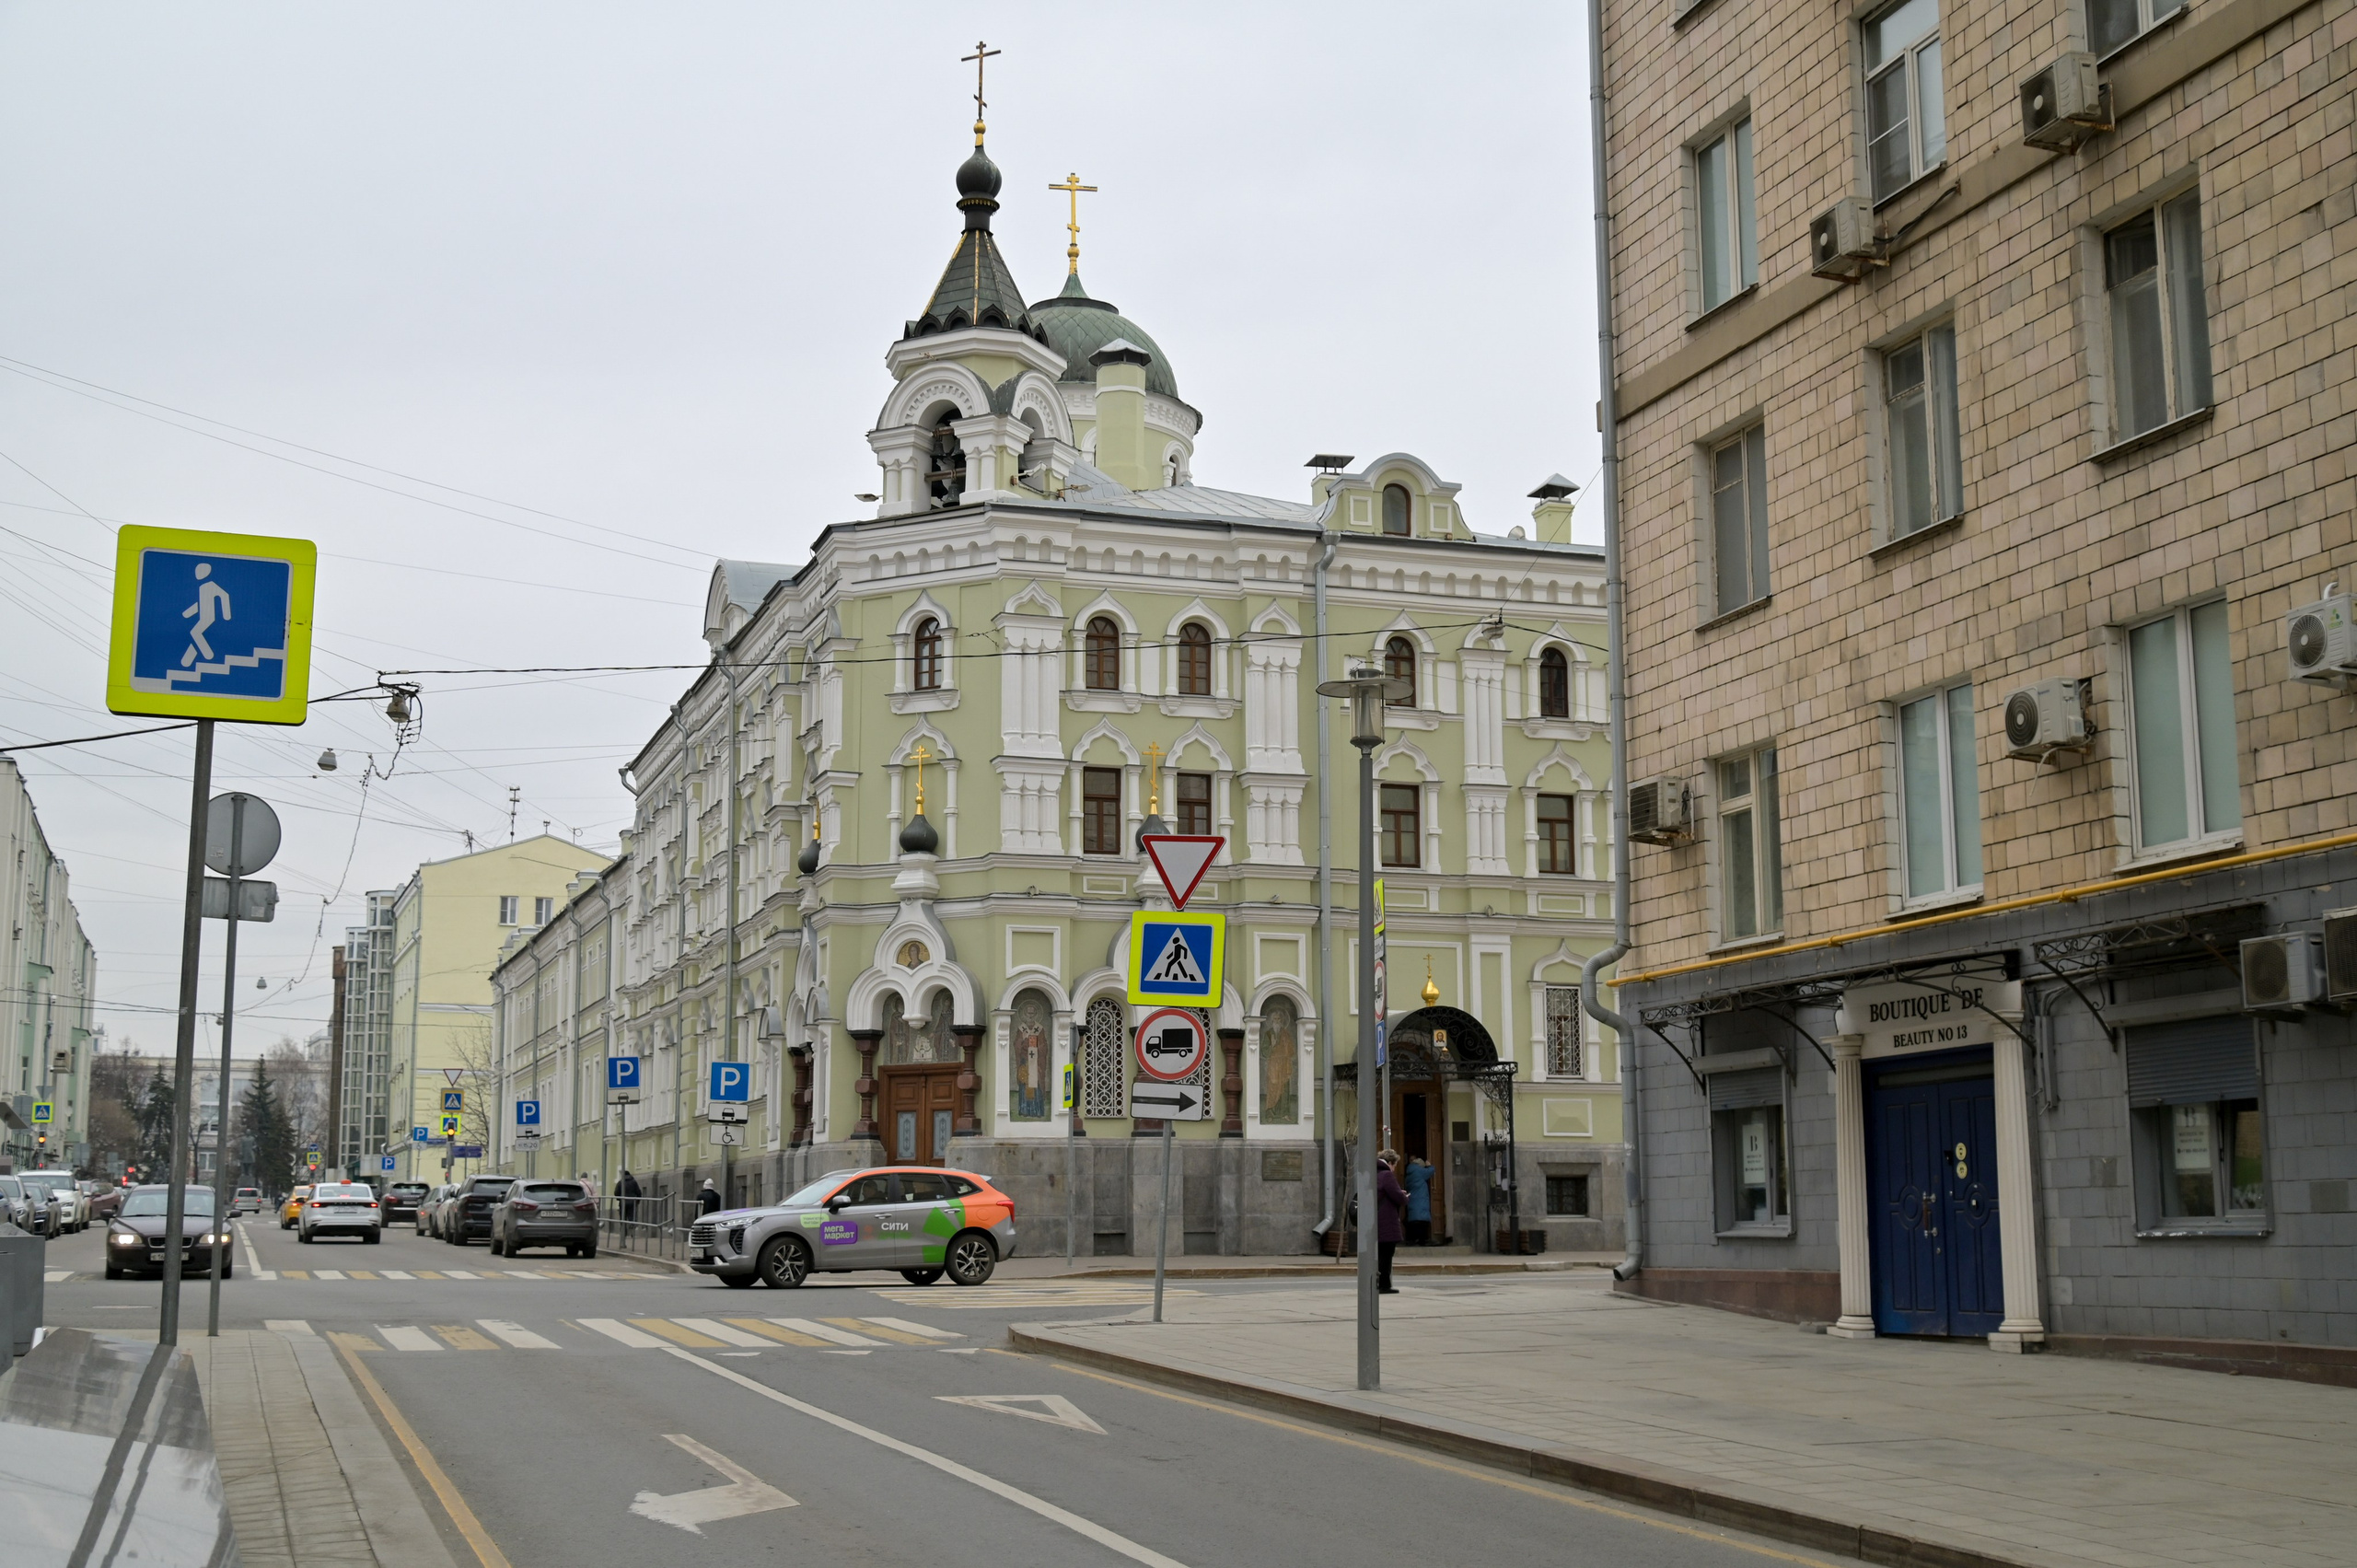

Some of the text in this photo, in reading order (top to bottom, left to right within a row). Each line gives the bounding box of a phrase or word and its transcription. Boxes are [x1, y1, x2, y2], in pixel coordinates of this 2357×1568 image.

[1869, 988, 1984, 1022] BOUTIQUE DE
[1377, 1025, 1384, 1063] P
[1893, 1025, 1968, 1048] BEAUTY NO 13
[616, 1060, 634, 1086] P
[720, 1066, 741, 1096] P
[522, 1103, 536, 1122] P
[416, 1129, 425, 1140] P
[385, 1157, 393, 1168] P
[824, 1231, 854, 1240] маркет
[881, 1222, 909, 1231] СИТИ
